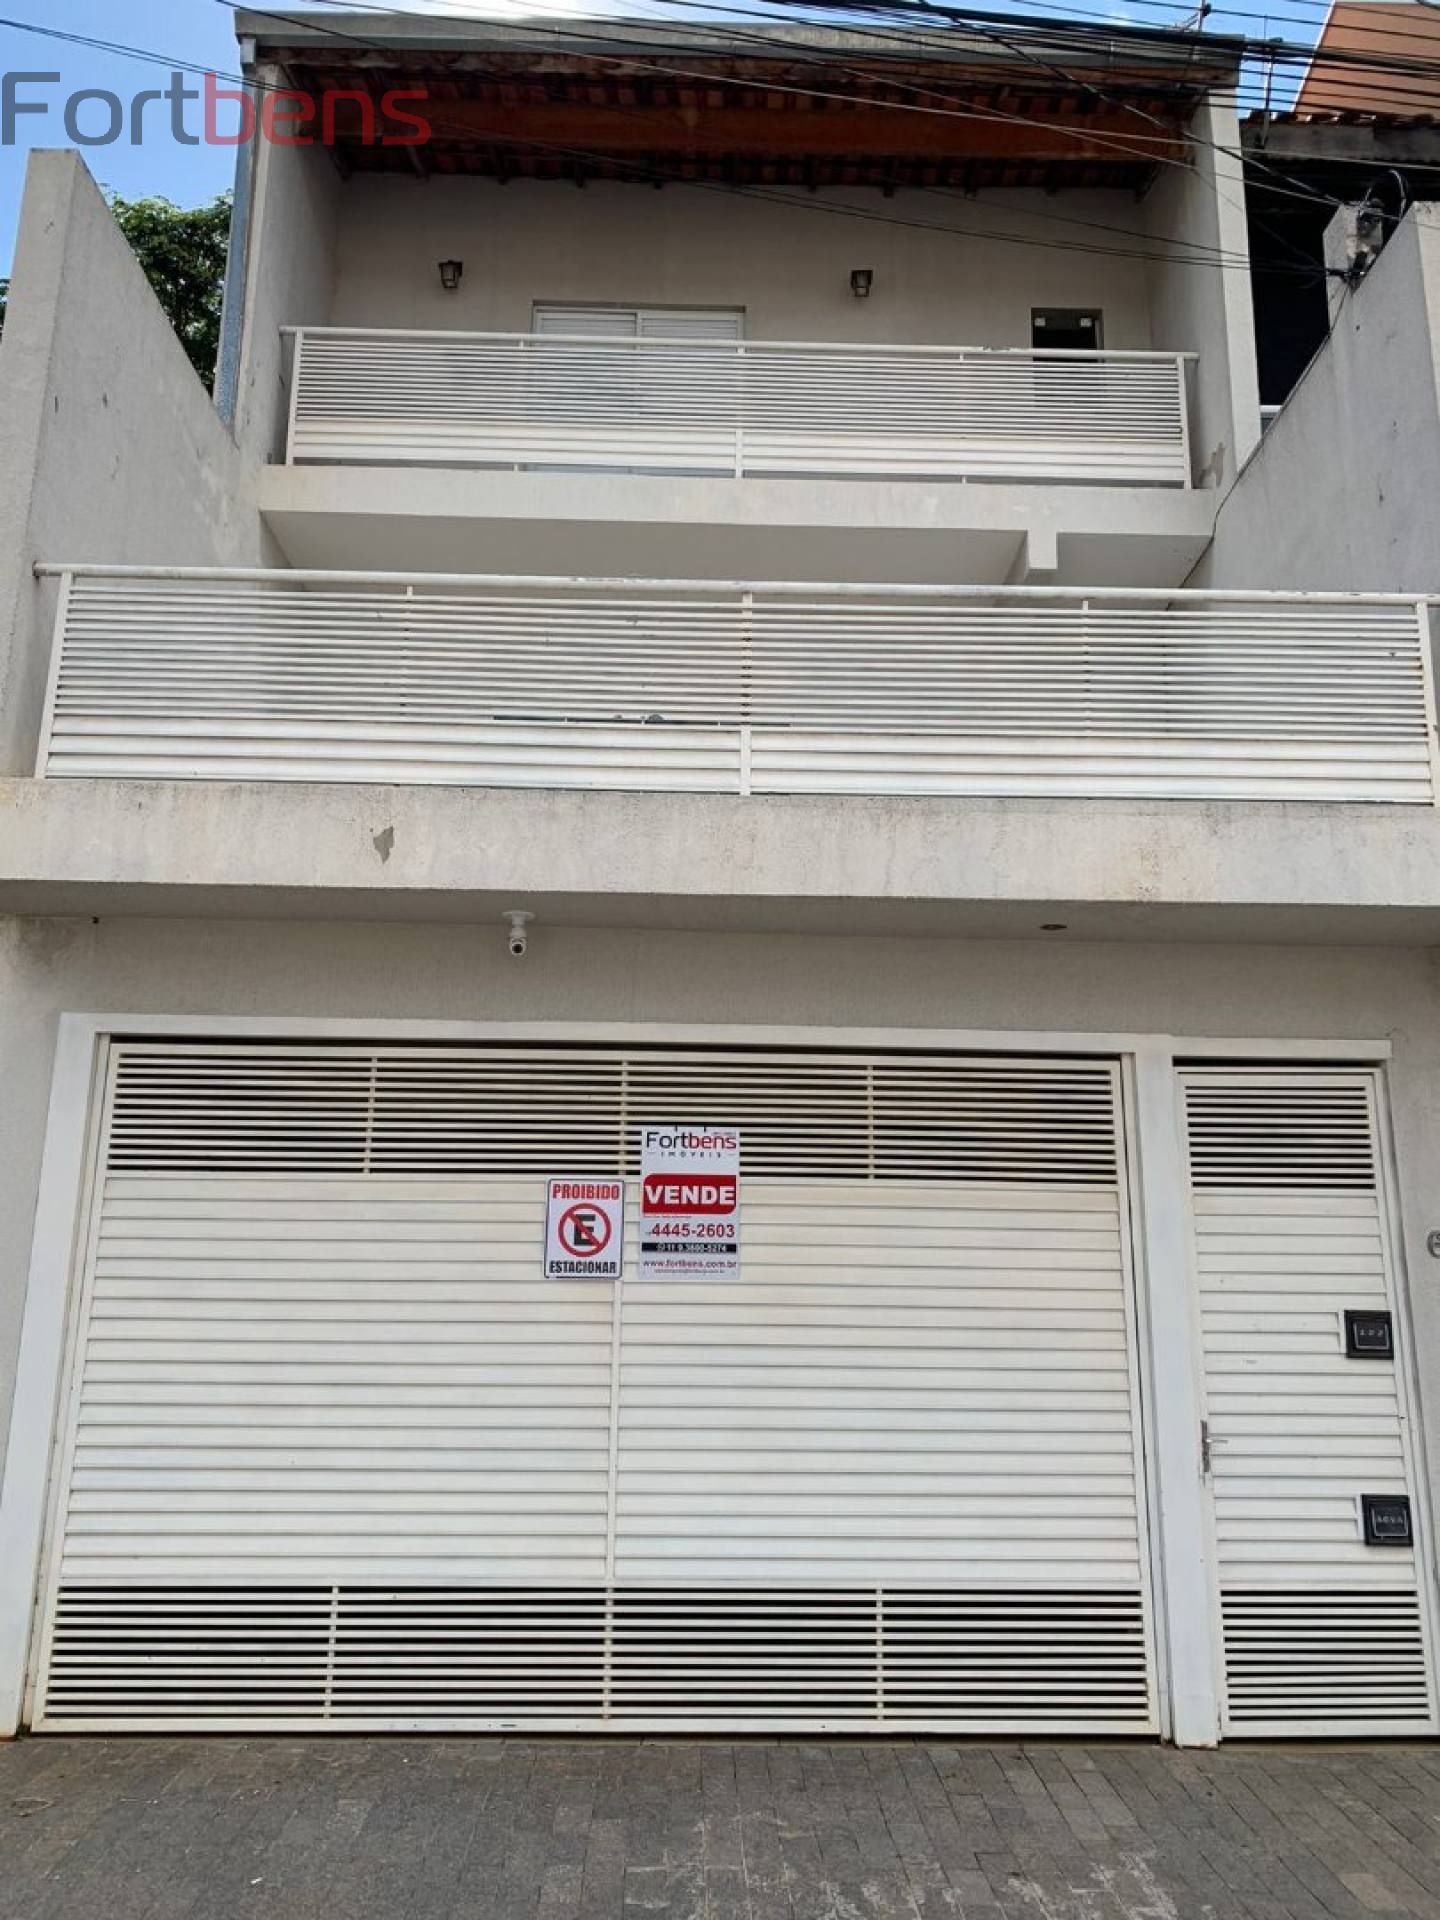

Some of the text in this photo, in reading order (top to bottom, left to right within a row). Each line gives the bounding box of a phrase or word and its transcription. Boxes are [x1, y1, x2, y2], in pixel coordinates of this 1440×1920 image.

[646, 1131, 737, 1149] Fortbens
[552, 1183, 620, 1200] PROIBIDO
[644, 1185, 735, 1205] VENDE
[652, 1222, 735, 1238] 4445-2603
[549, 1260, 617, 1274] ESTACIONAR
